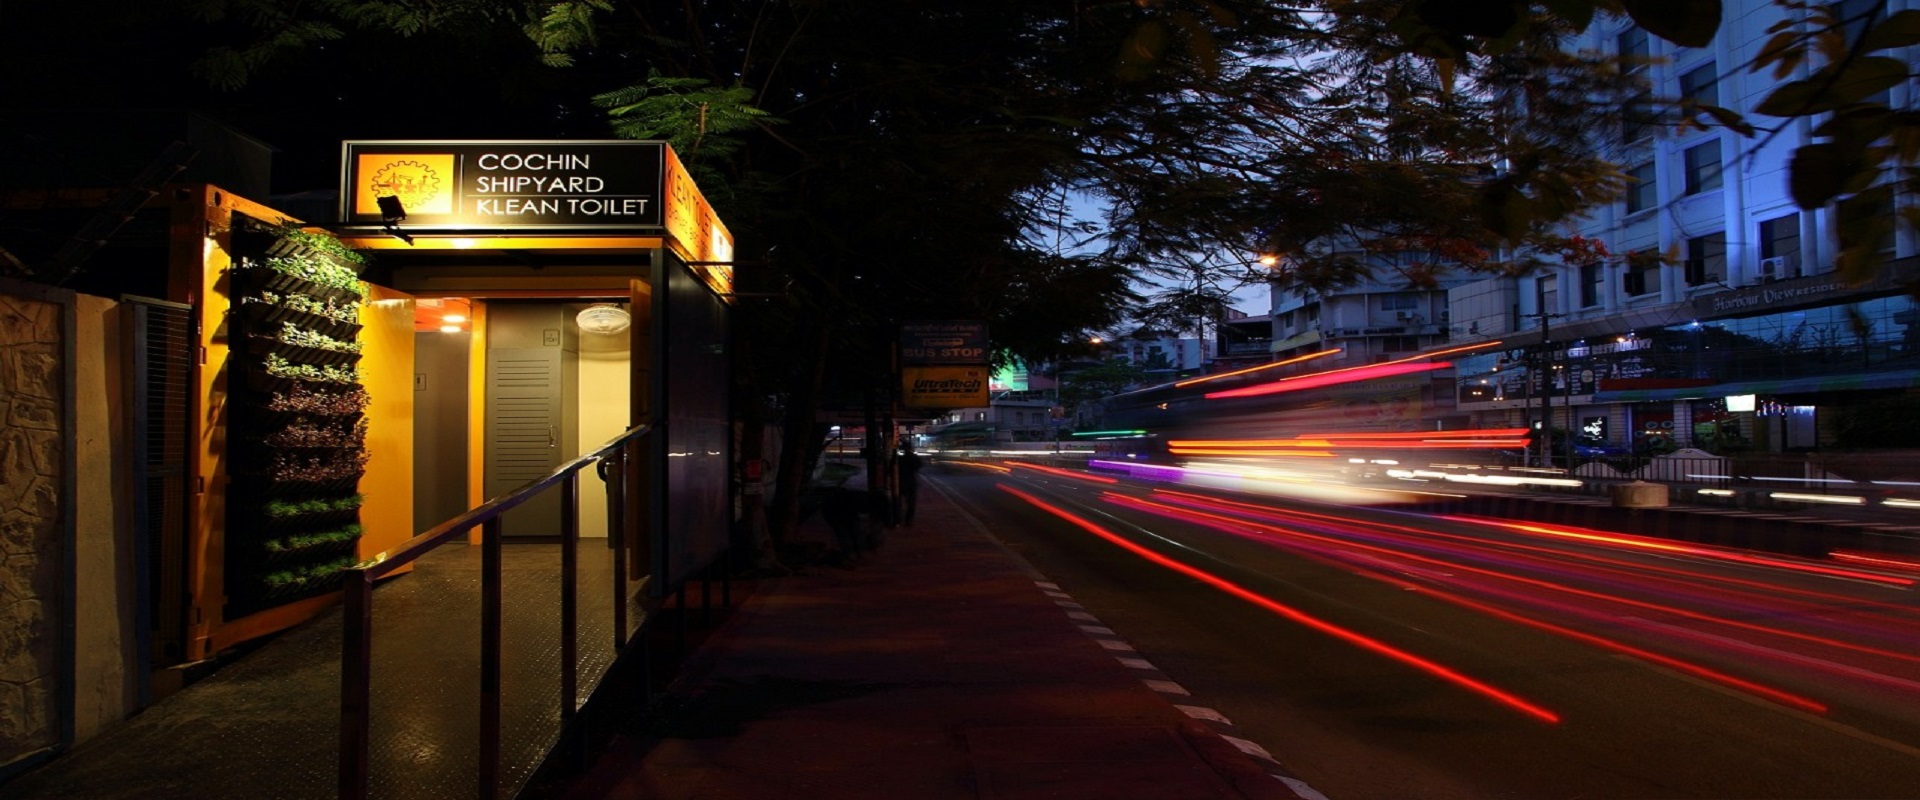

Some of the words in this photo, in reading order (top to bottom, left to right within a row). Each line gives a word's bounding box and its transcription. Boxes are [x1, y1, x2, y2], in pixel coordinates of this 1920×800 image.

[478, 154, 590, 170] COCHIN
[476, 176, 604, 193] SHIPYARD
[477, 199, 559, 215] KLEAN
[567, 199, 648, 215] TOILET
[1714, 295, 1759, 311] Harbour
[1763, 288, 1795, 304] View
[903, 348, 936, 357] BUS
[941, 348, 983, 357] STOP
[914, 379, 981, 388] UltraTech
